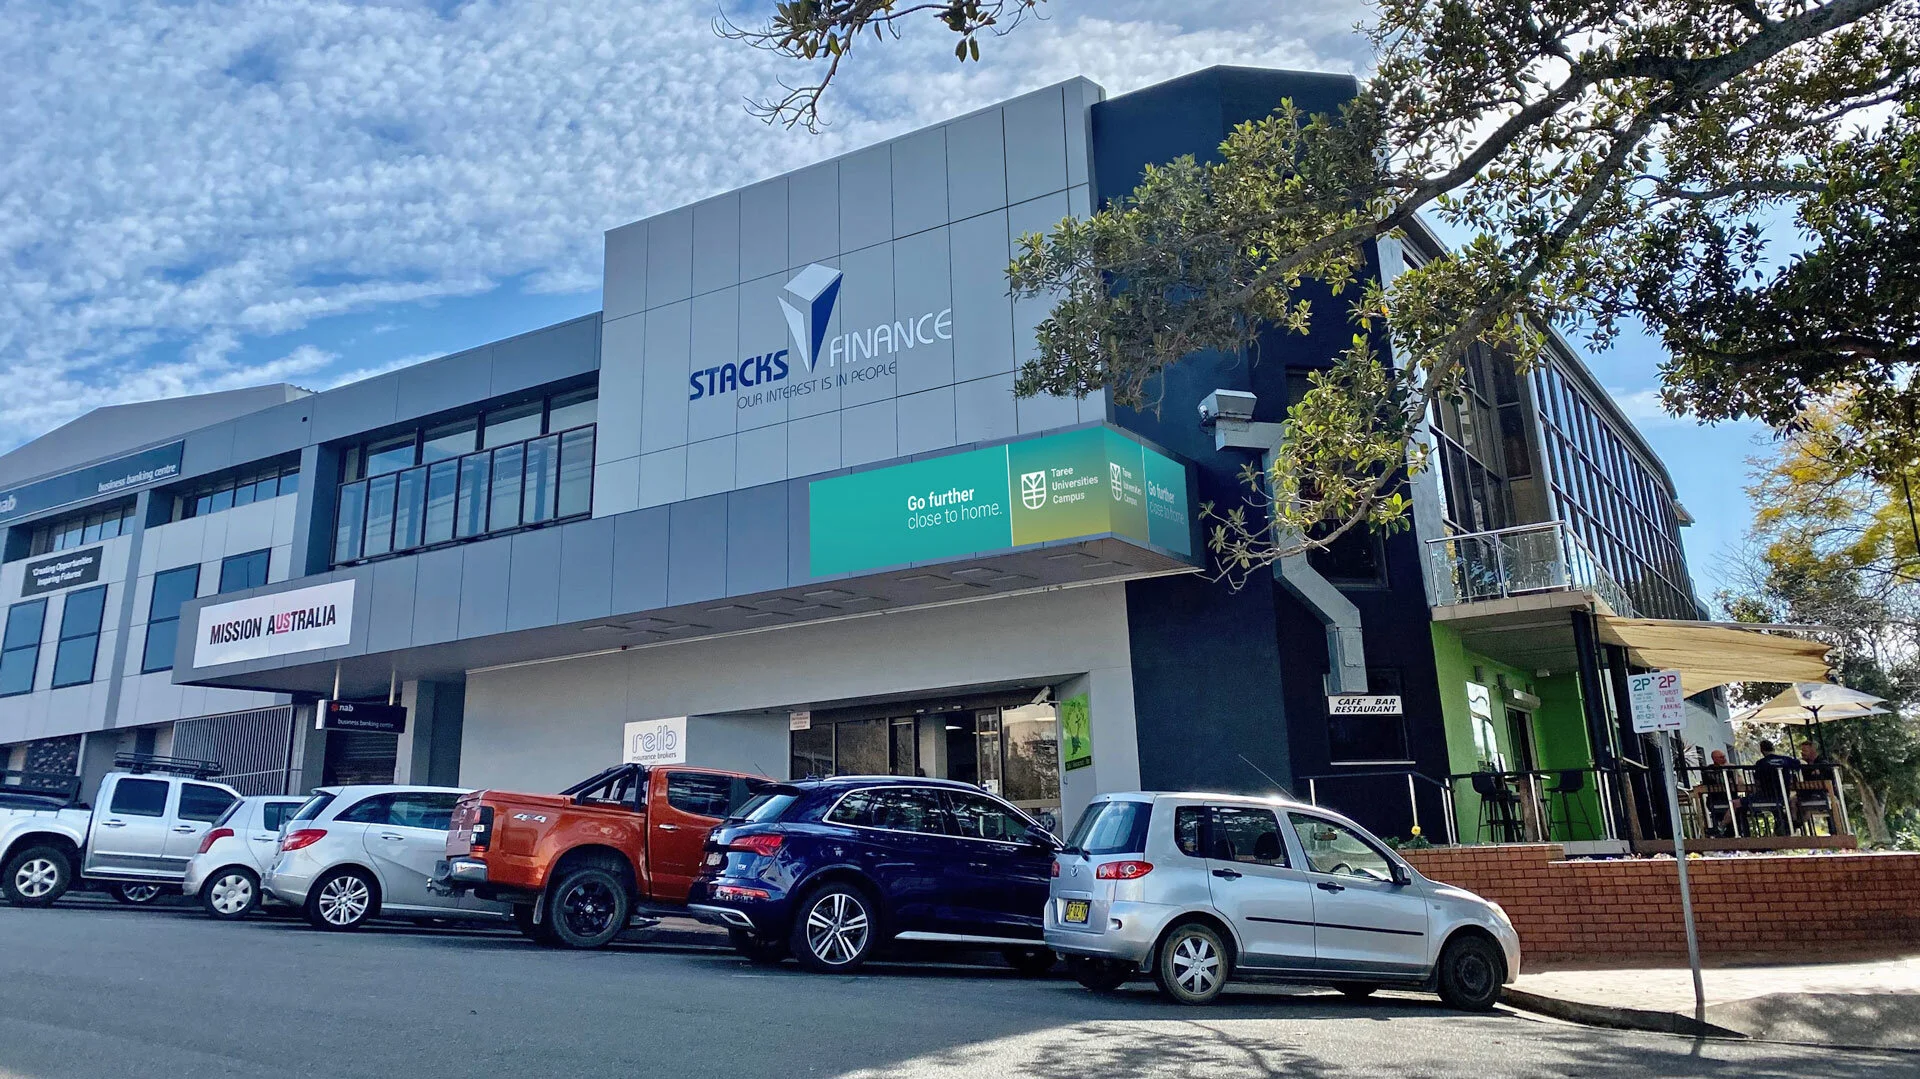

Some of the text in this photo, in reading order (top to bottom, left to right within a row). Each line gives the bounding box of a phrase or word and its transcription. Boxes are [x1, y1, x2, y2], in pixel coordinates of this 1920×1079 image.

[829, 308, 952, 367] FINANCE
[689, 349, 789, 401] STACKS
[737, 361, 896, 409] OUR INTEREST IS IN PEOPLE
[98, 464, 177, 493] business banking centre
[1051, 466, 1074, 477] Taree
[1052, 475, 1099, 491] Universities
[907, 486, 975, 511] Go further
[1052, 491, 1085, 504] Campus
[1148, 481, 1175, 504] Go further
[908, 500, 1003, 530] close to home.
[209, 604, 336, 645] MISSION AUSTRALIA
[1632, 678, 1651, 692] 2P
[1658, 675, 1677, 689] 2P
[339, 704, 354, 712] nab
[1334, 705, 1397, 713] RESTAURANT
[1375, 698, 1397, 706] BAR
[338, 718, 359, 726] business
[360, 719, 379, 729] banking
[632, 725, 677, 754] reib
[632, 751, 677, 762] insurance brokers
